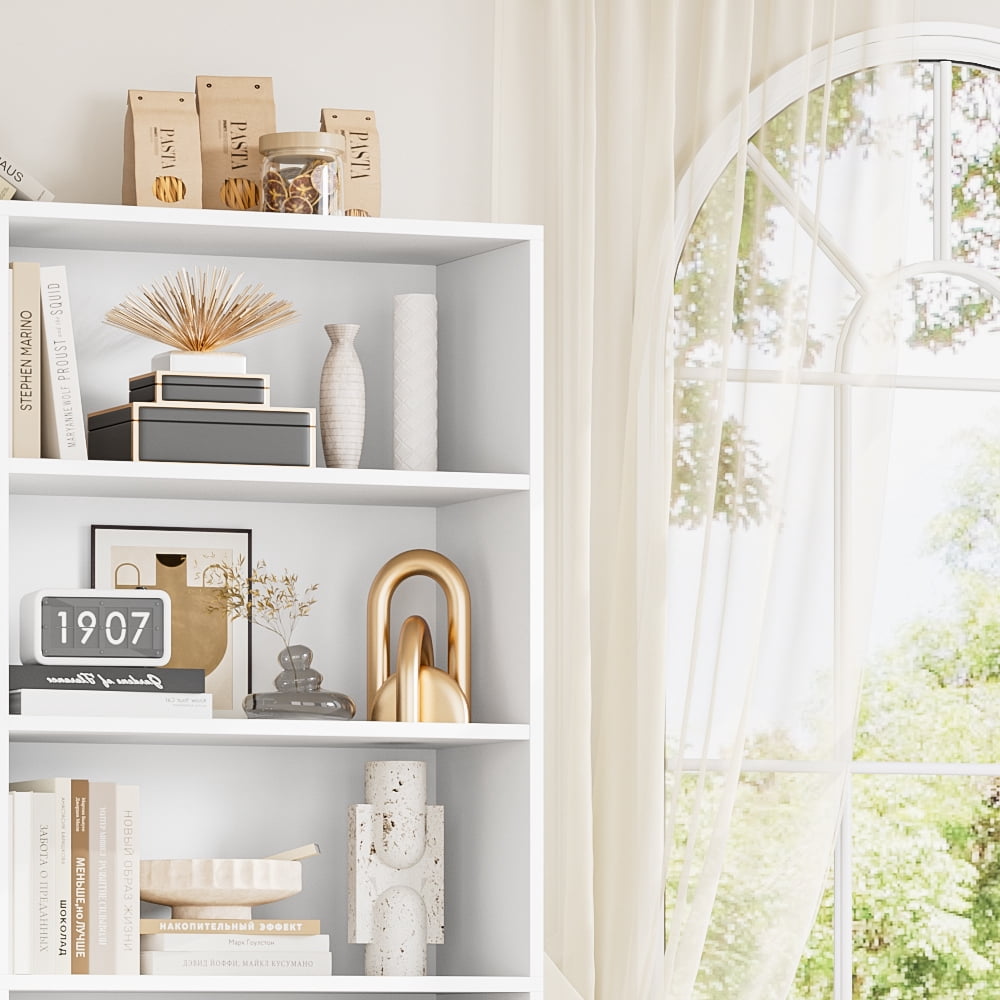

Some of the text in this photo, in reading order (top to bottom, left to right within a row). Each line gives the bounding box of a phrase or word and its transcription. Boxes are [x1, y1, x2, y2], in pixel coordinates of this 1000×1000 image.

[160, 128, 176, 169] PASTA
[230, 121, 248, 170] PASTA
[350, 132, 370, 179] PASTA
[47, 282, 70, 381] PROUST SQUID
[20, 310, 32, 411] STEPHEN MARINO
[58, 611, 150, 645] 1907
[39, 825, 48, 952] ЗАБОТА О ПРЕДАННЫХ
[123, 810, 133, 951] НОВЫЙ ОБРАЗ ЖИЗНИ
[59, 900, 67, 956] ШОКОЛАД
[75, 921, 85, 958] ЛУЧШЕ
[160, 921, 303, 931] НАКОПИТЕЛЬНЫЙ ЭФФЕКТ
